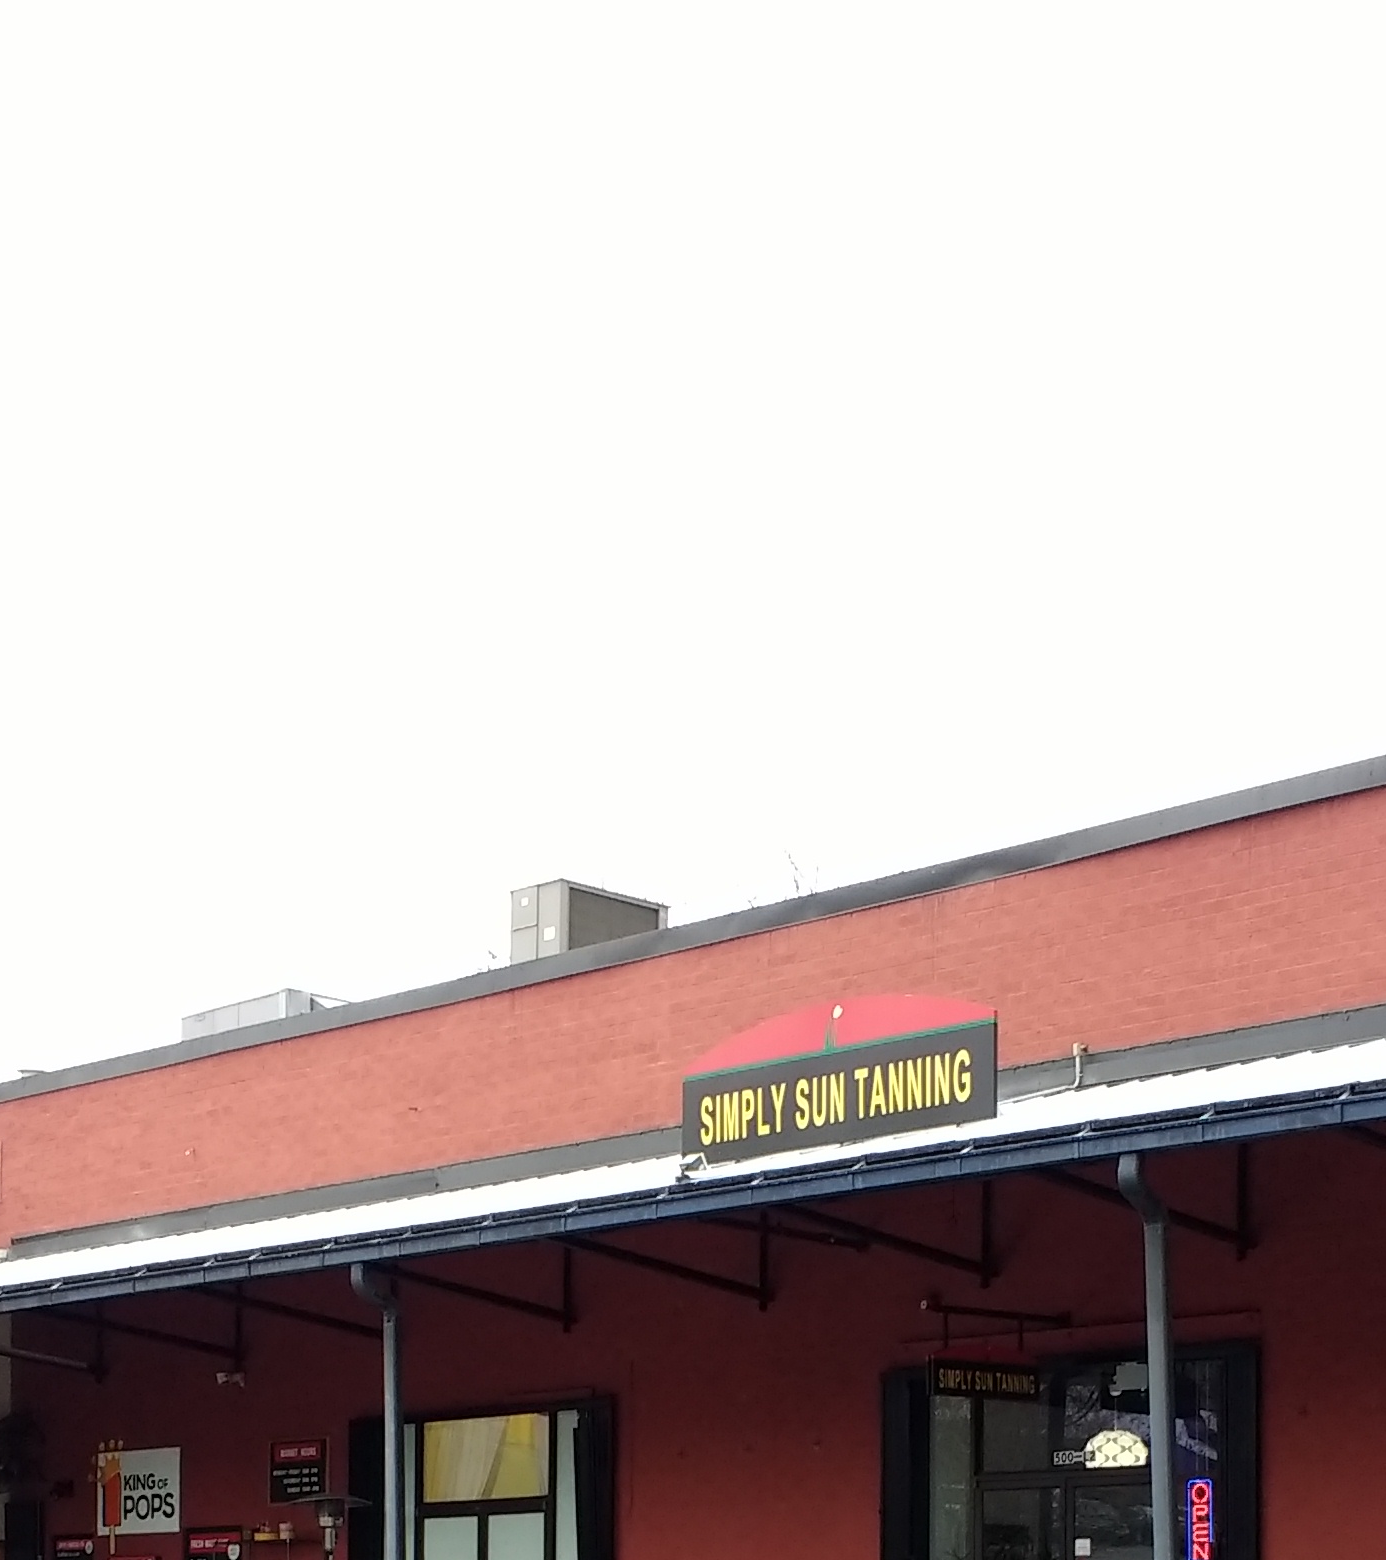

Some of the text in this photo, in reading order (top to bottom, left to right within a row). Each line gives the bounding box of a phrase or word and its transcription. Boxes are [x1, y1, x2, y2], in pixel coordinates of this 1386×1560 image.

[700, 1049, 972, 1146] SIMPLY SUN TANNING
[939, 1368, 1035, 1394] SIMPLY SUN TANNING
[123, 1472, 156, 1492] KING
[123, 1492, 175, 1520] POPS
